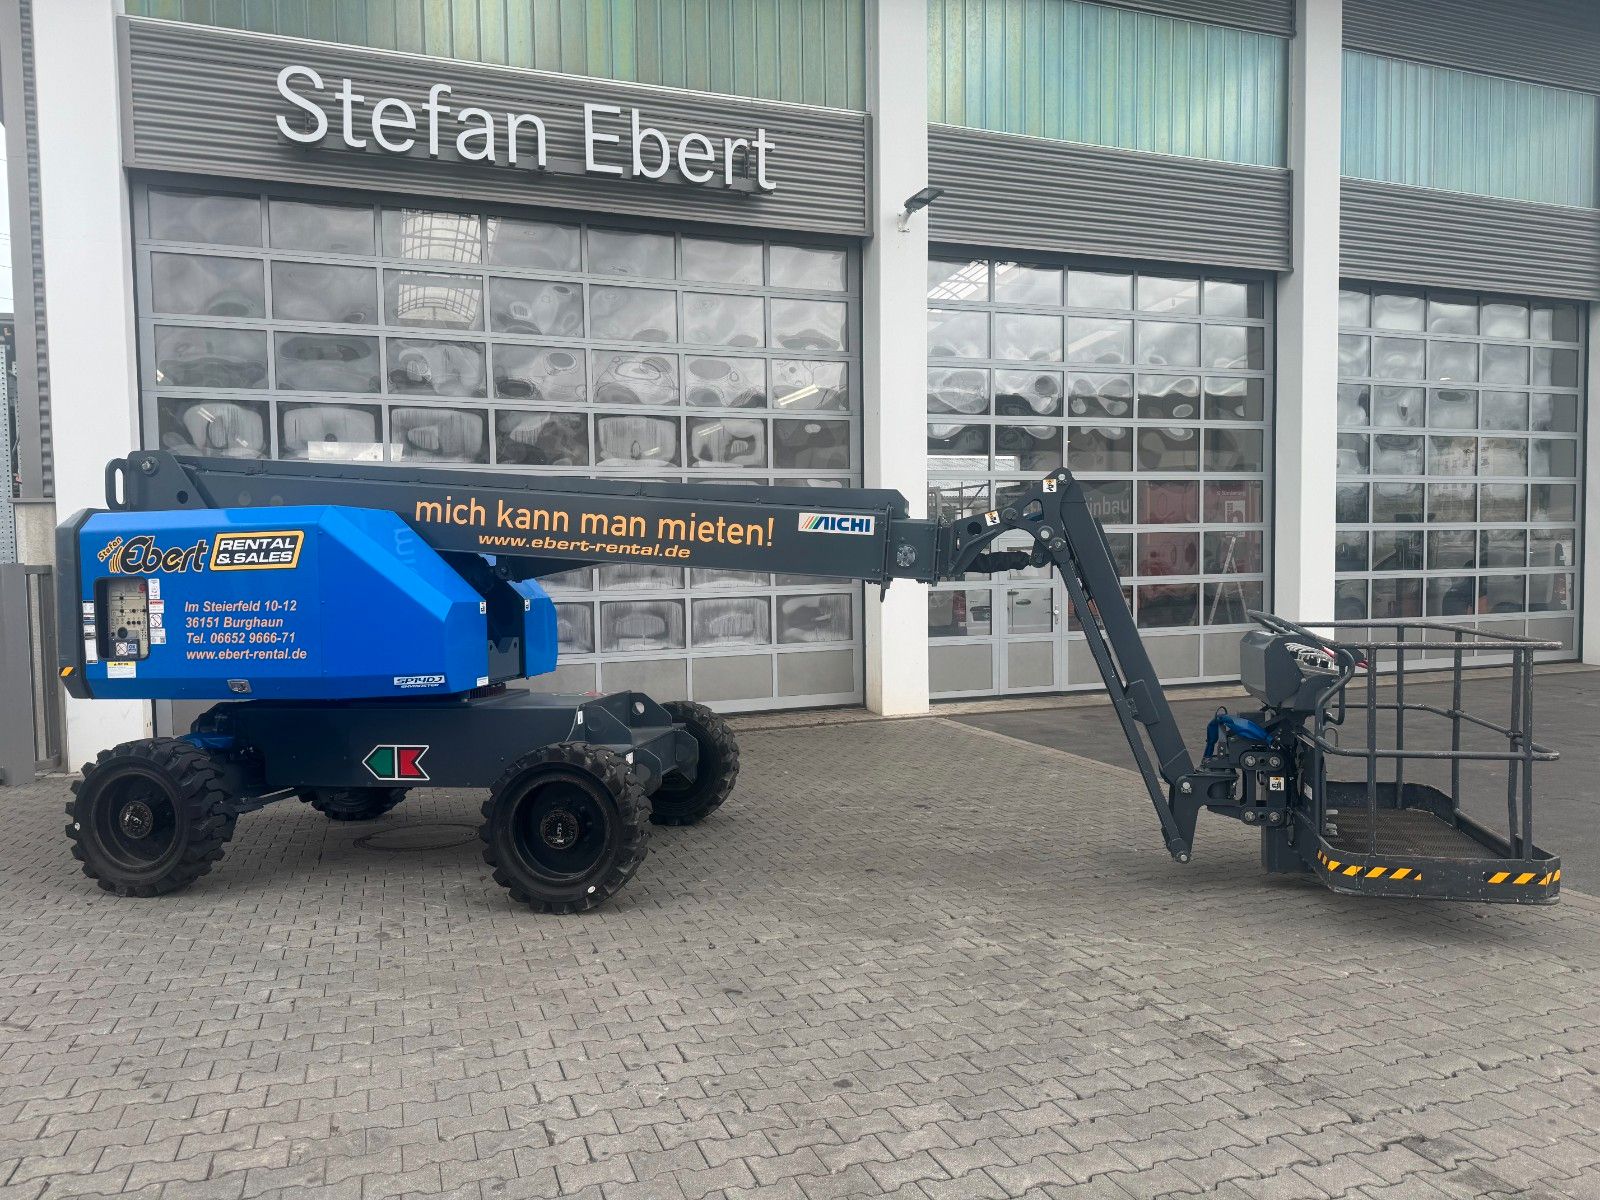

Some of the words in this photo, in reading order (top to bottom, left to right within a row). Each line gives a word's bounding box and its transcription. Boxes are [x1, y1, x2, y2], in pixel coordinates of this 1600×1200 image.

[276, 65, 547, 169] Stefan
[583, 102, 777, 190] Ebert
[415, 496, 486, 526] mich
[497, 499, 569, 532] kann
[580, 512, 646, 538] man
[657, 512, 774, 547] mieten!
[803, 515, 875, 533] AICHI
[98, 536, 122, 562] Stefan
[219, 538, 295, 551] RENTAL
[478, 535, 691, 558] www.ebert-rental.de
[119, 535, 210, 574] Ebert
[216, 552, 231, 564] &
[233, 551, 293, 564] SALES
[184, 601, 199, 612] Im
[203, 601, 261, 612] Steierfeld
[264, 600, 297, 612] 10-12
[185, 617, 219, 628] 36151
[223, 616, 283, 630] Burghaun
[186, 633, 206, 644] Tel.
[210, 633, 245, 644] 06652
[249, 632, 295, 643] 9666-71
[186, 648, 307, 660] www.ebert-rental.de
